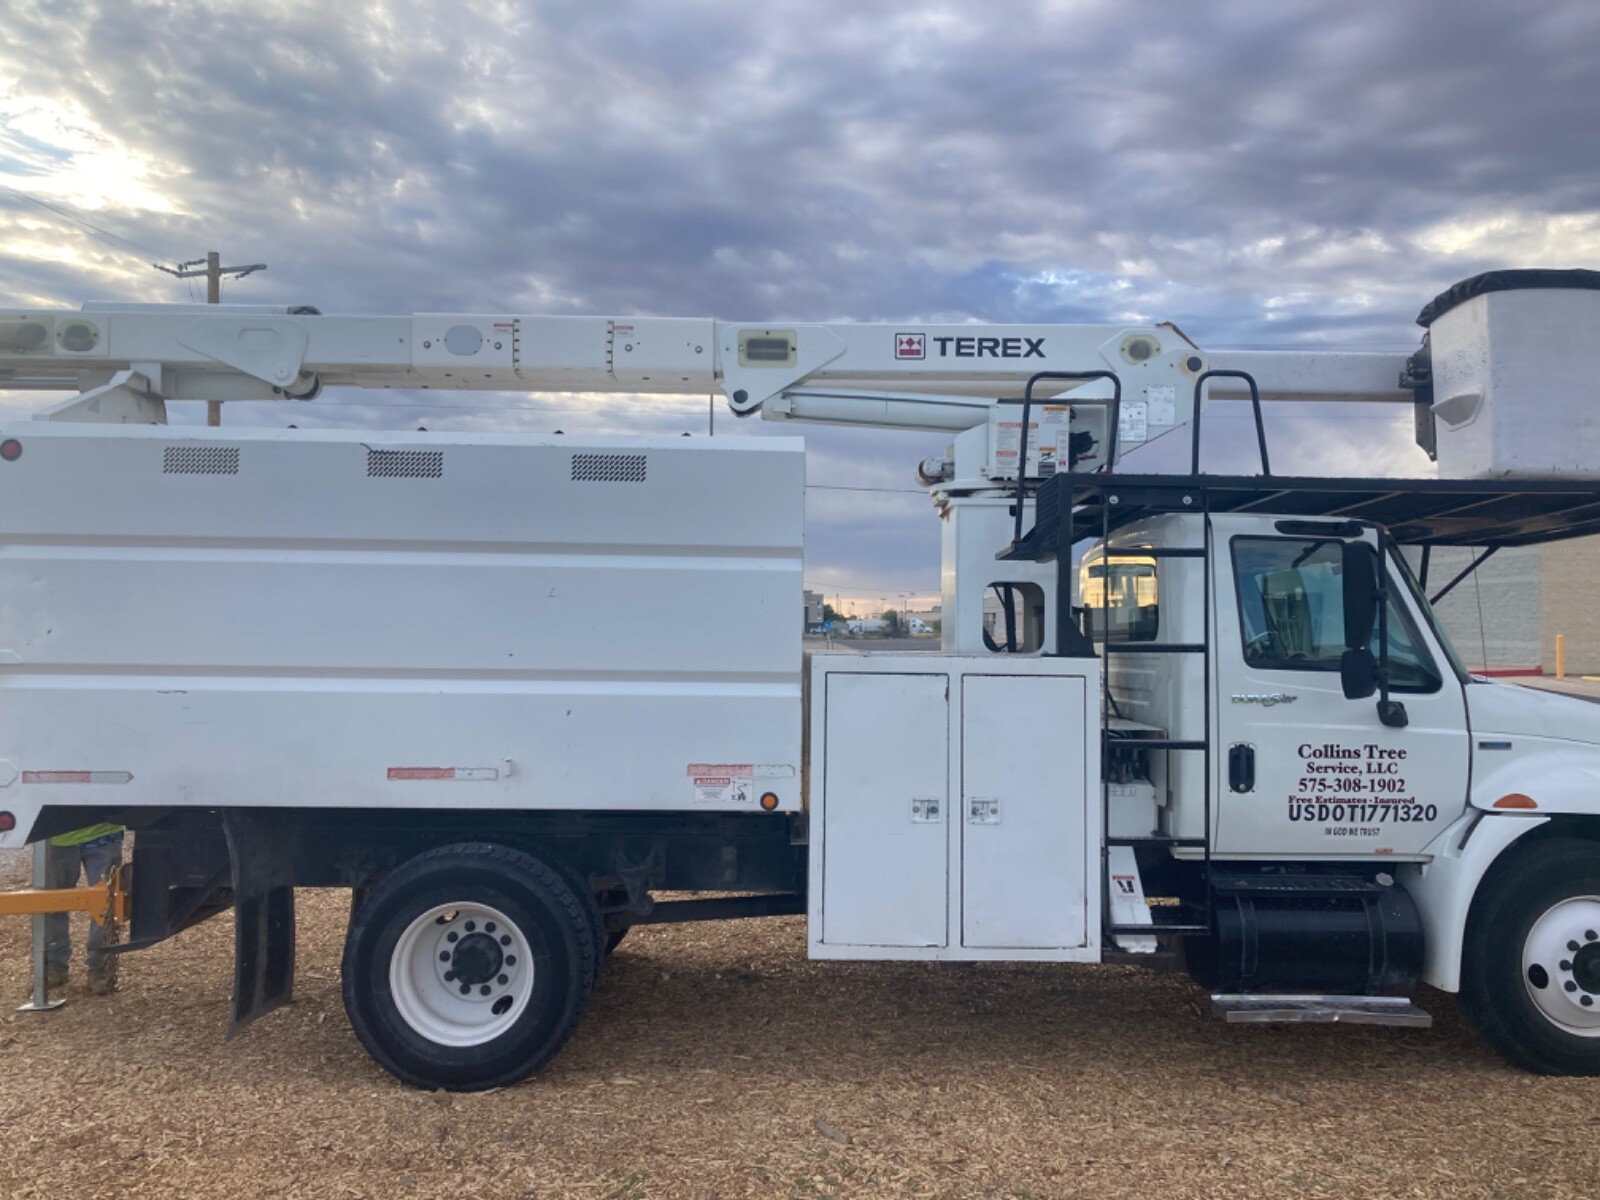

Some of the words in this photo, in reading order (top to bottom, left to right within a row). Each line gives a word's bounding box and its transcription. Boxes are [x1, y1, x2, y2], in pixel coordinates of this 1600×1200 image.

[933, 337, 1046, 358] TEREX
[1298, 744, 1361, 759] Collins
[1363, 744, 1407, 760] Tree
[1306, 761, 1362, 776] Service,
[1366, 762, 1398, 774] LLC
[1298, 778, 1406, 793] 575-308-1902
[1288, 795, 1313, 804] Free
[1315, 795, 1367, 804] Estimates
[1374, 796, 1415, 804] Insured
[1324, 827, 1332, 835] IN
[1333, 827, 1348, 836] GOD
[1349, 827, 1358, 836] WE
[1359, 827, 1380, 836] TRUST
